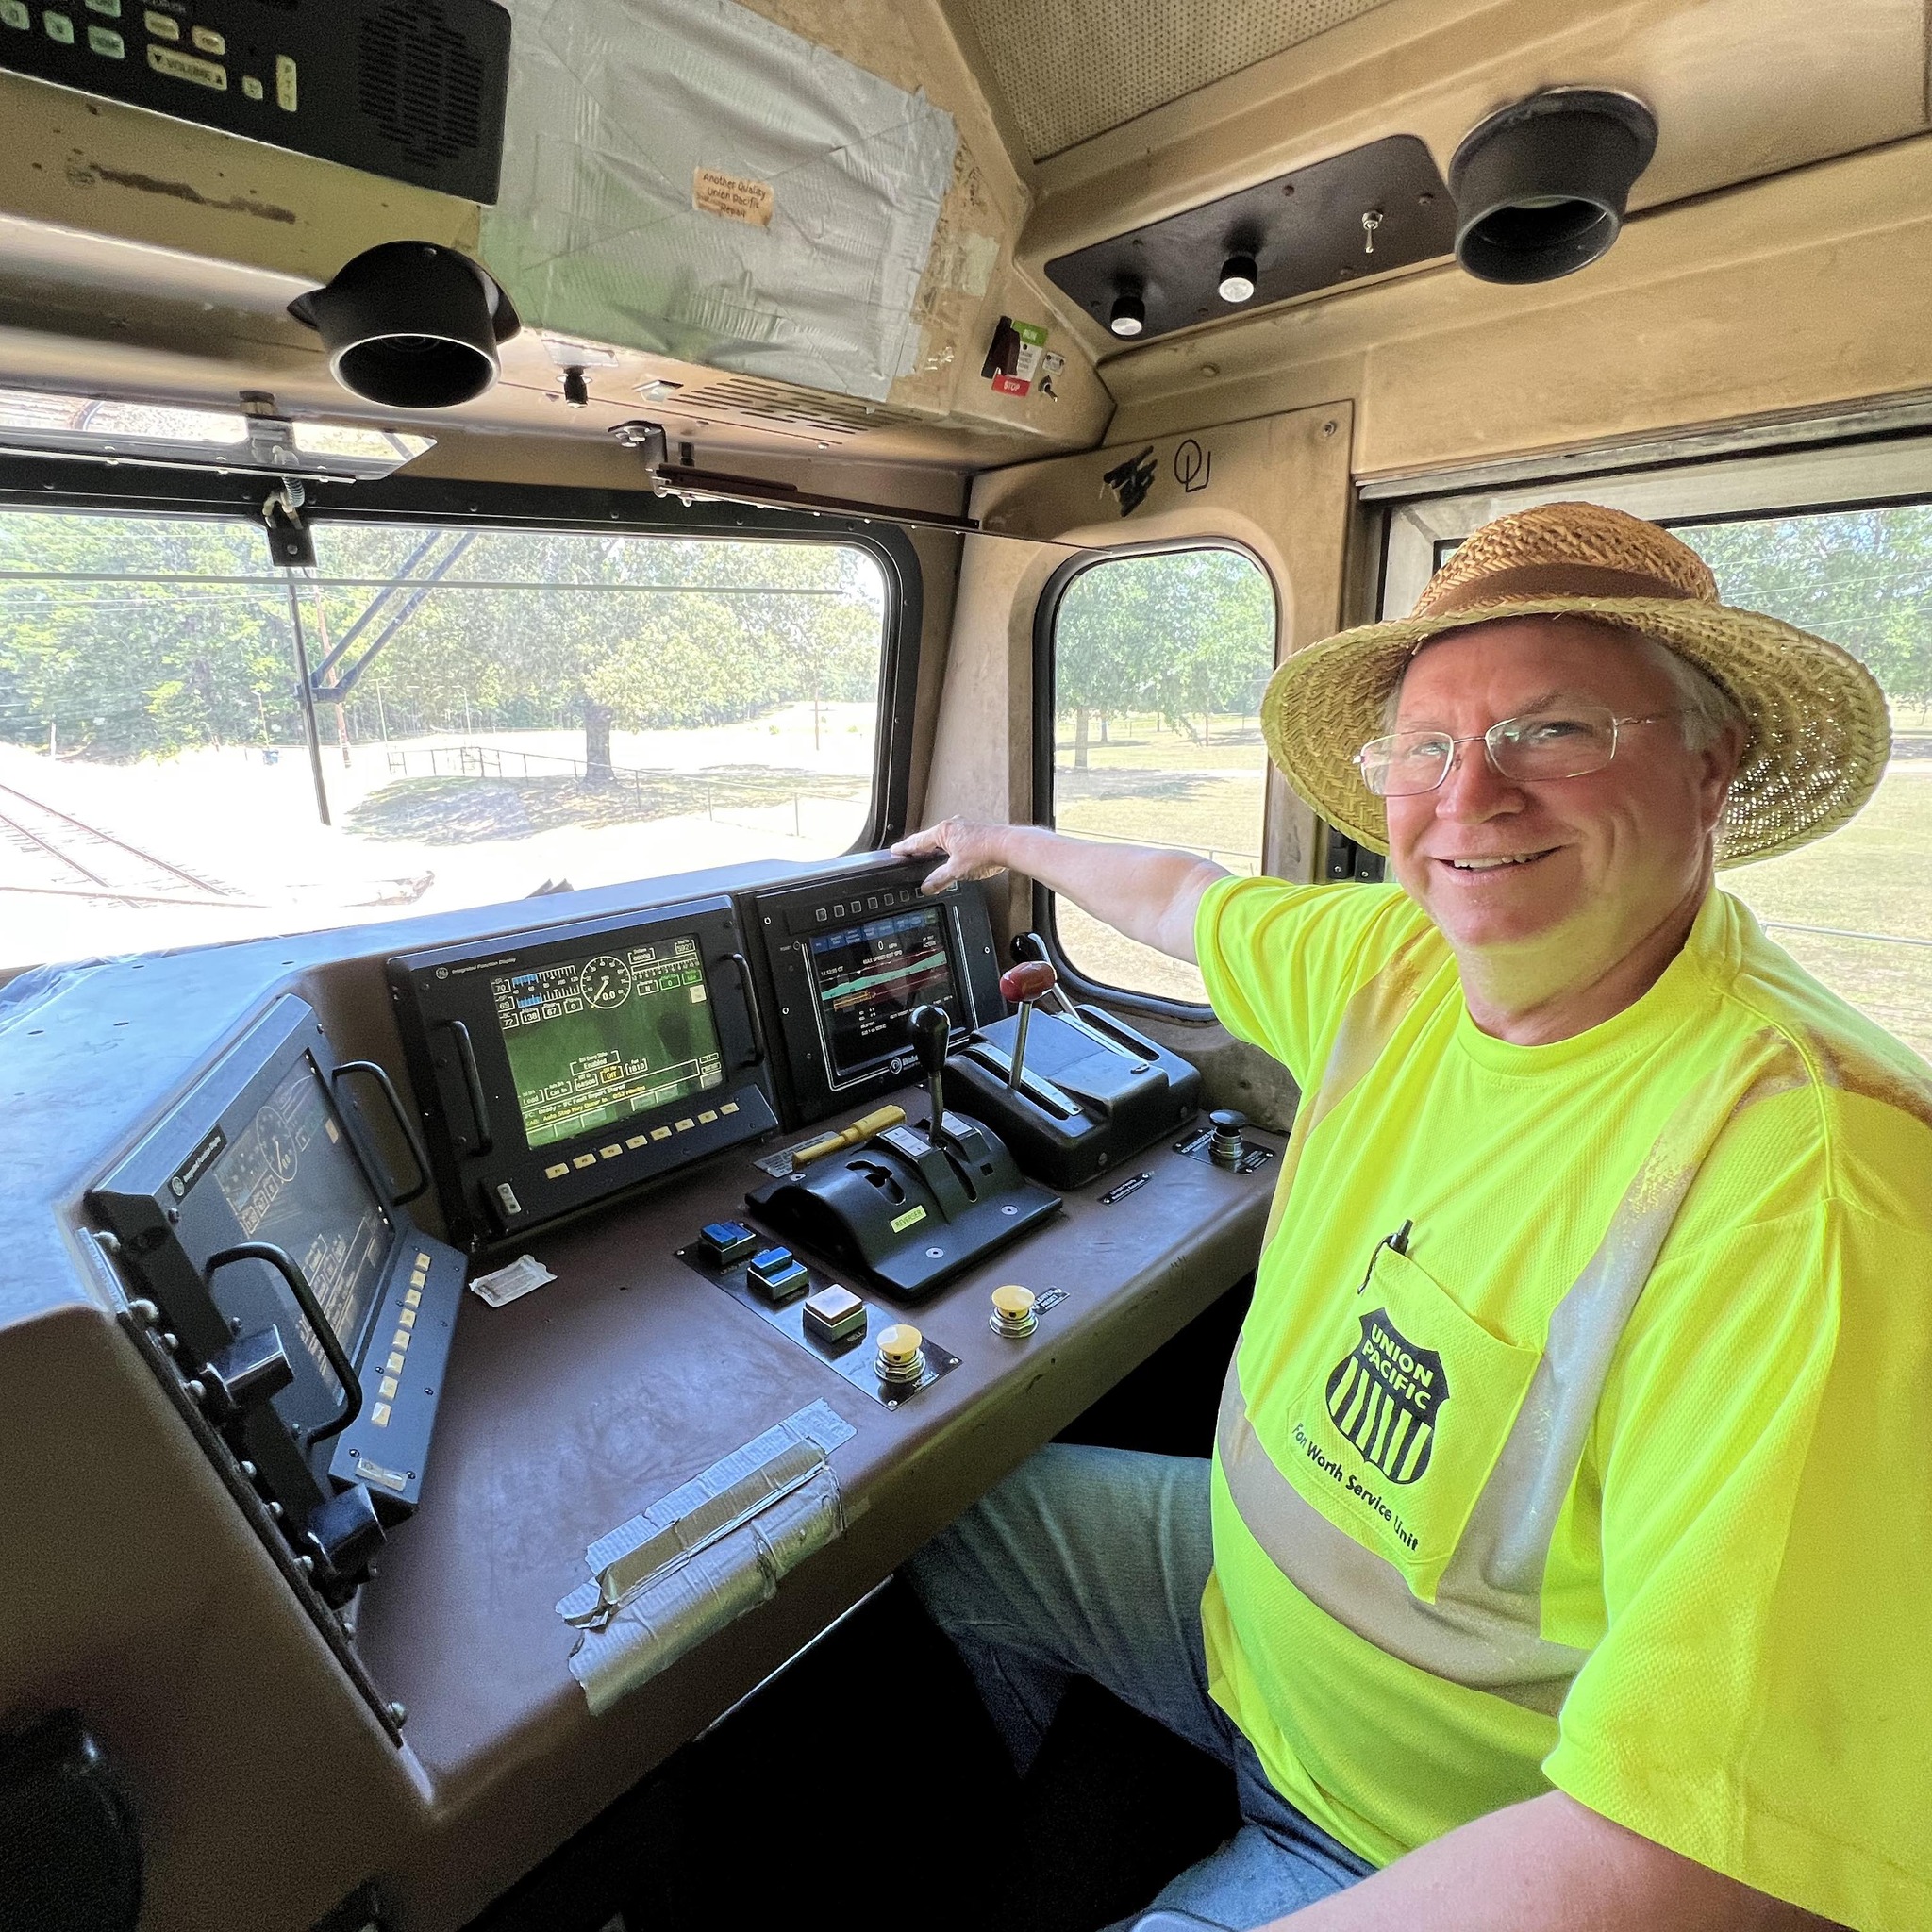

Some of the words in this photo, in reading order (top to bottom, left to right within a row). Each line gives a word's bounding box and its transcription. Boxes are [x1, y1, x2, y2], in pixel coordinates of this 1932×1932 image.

[703, 173, 736, 189] Another
[737, 180, 766, 201] Quality
[707, 186, 730, 199] Union
[732, 193, 759, 208] Pacific
[720, 203, 746, 218] Repair
[1003, 380, 1021, 391] STOP
[877, 941, 884, 951] 0
[495, 984, 506, 992] 70
[602, 991, 616, 1001] 0.0
[499, 1001, 509, 1009] 69
[524, 1013, 538, 1022] 138
[583, 1058, 608, 1070] Enabled
[572, 1105, 583, 1113] May
[894, 1209, 923, 1228] REVERSER
[847, 1331, 864, 1342] BELL
[1371, 1323, 1434, 1388] UNION
[1361, 1338, 1432, 1411] PACIFIC
[1307, 1441, 1343, 1482] Worth
[1345, 1474, 1392, 1522] Service
[1393, 1515, 1420, 1552] Unit
